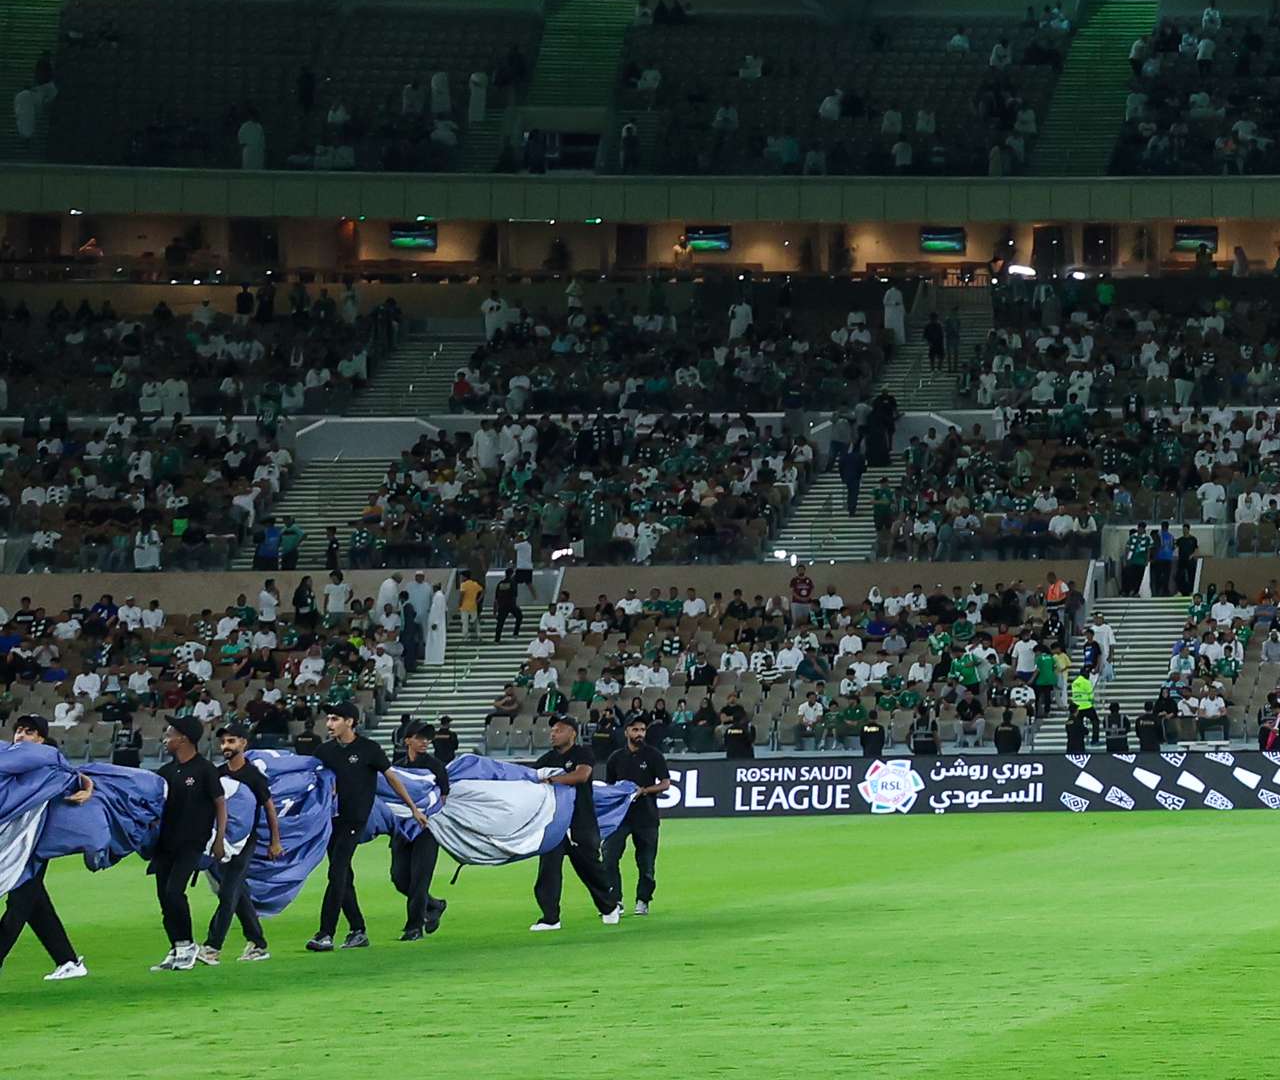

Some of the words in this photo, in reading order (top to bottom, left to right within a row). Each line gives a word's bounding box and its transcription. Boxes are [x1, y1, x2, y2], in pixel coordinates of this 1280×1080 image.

[736, 767, 797, 782] ROSHN
[800, 766, 852, 781] SAUDI
[930, 758, 989, 780] روشن
[992, 762, 1044, 784] دوري
[880, 780, 902, 791] RSL
[735, 785, 851, 811] LEAGUE
[929, 782, 1044, 813] السعودي
